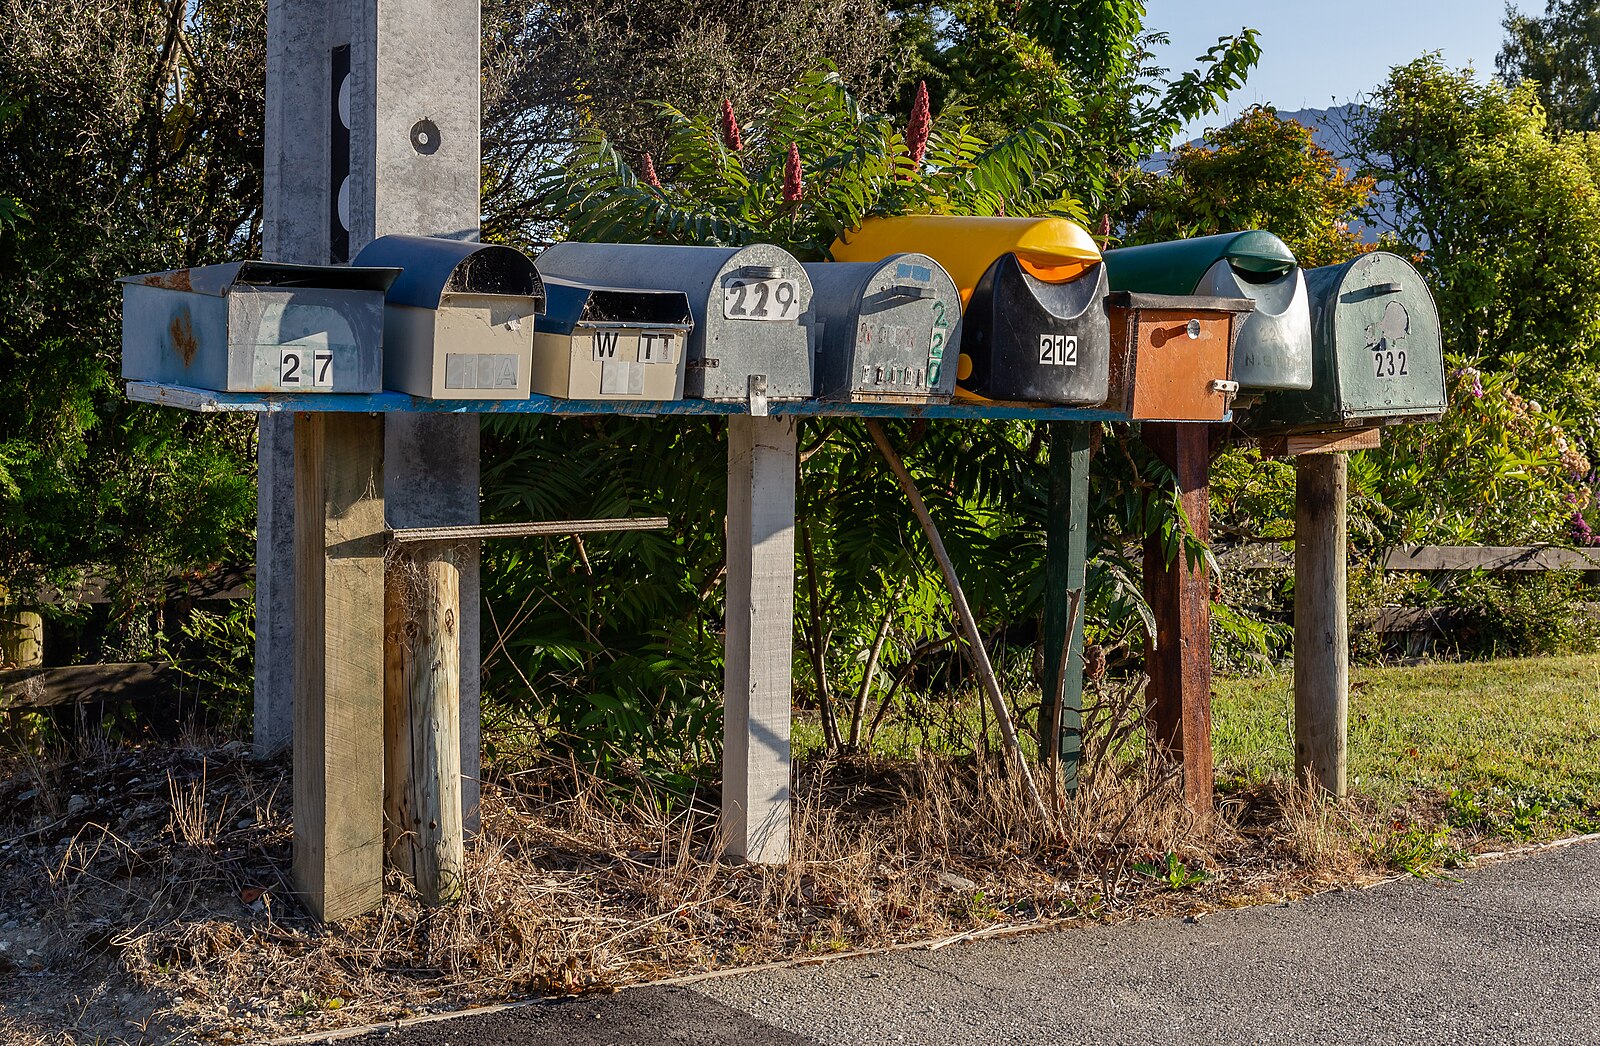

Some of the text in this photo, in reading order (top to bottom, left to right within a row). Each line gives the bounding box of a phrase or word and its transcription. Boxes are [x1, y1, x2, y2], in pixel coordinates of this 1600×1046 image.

[729, 281, 794, 317] 229
[927, 300, 949, 387] 220
[1041, 338, 1076, 362] 212
[1375, 351, 1408, 377] 232
